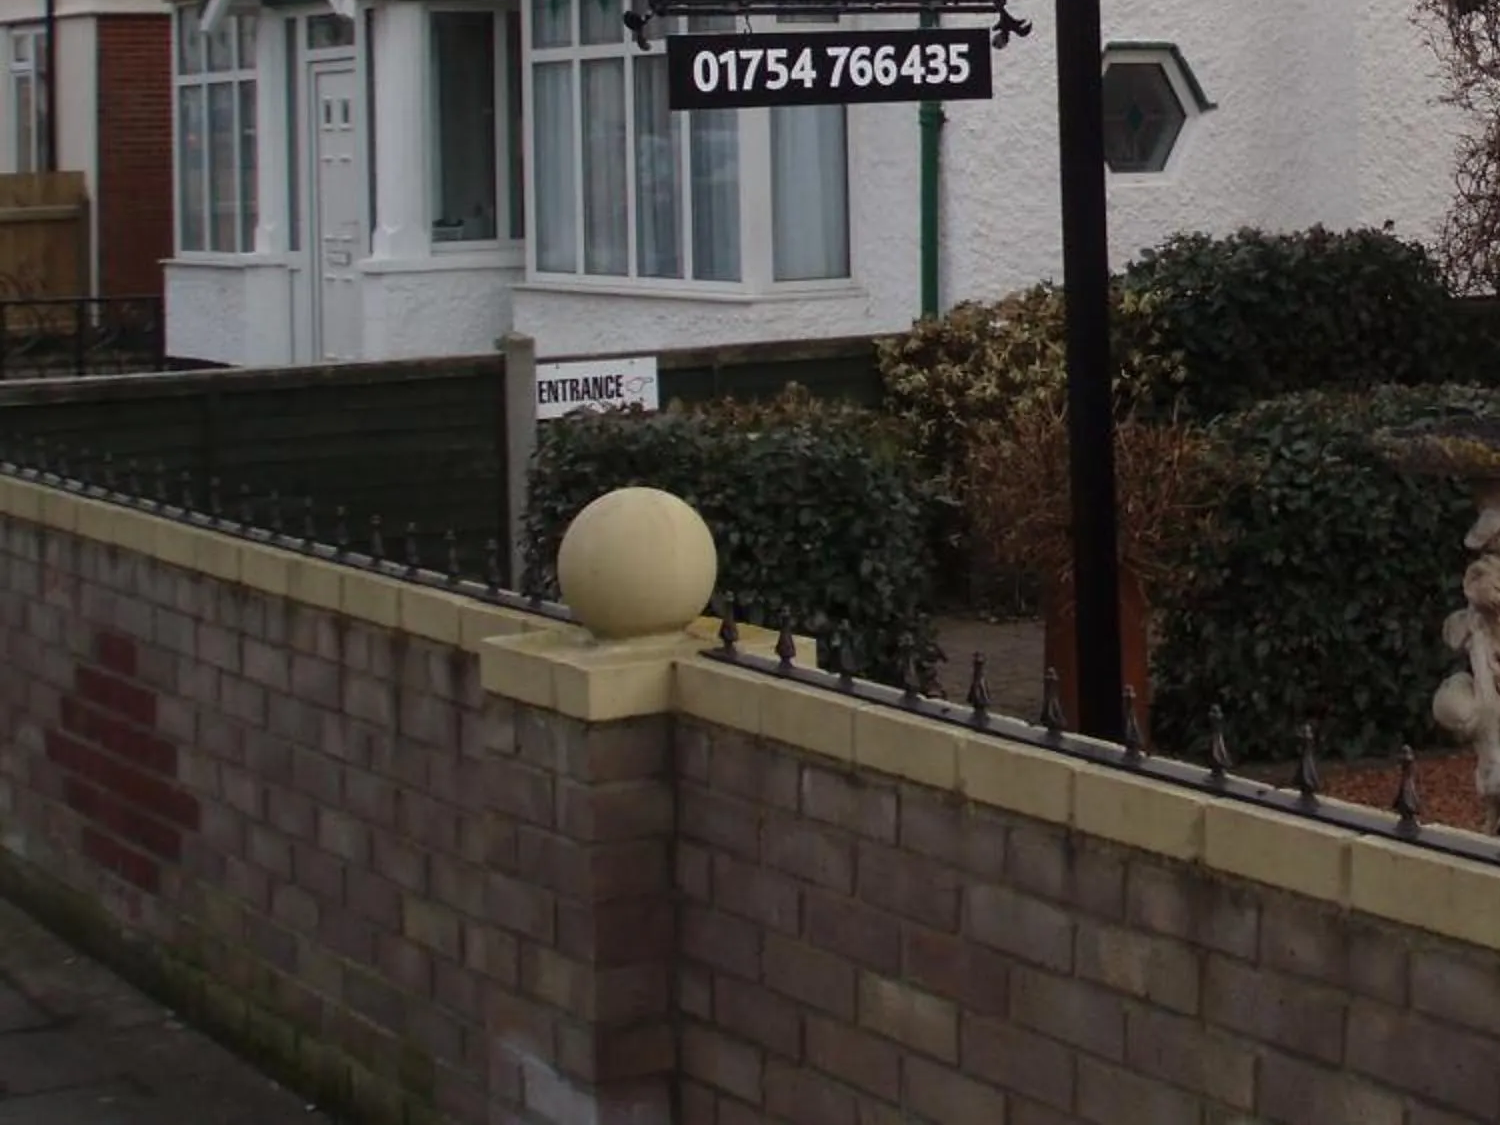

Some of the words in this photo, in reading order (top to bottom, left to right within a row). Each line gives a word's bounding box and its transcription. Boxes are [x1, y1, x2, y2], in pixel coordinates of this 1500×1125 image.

[693, 48, 817, 92] 01754
[826, 43, 970, 87] 766435
[537, 374, 624, 404] ENTRANCE
